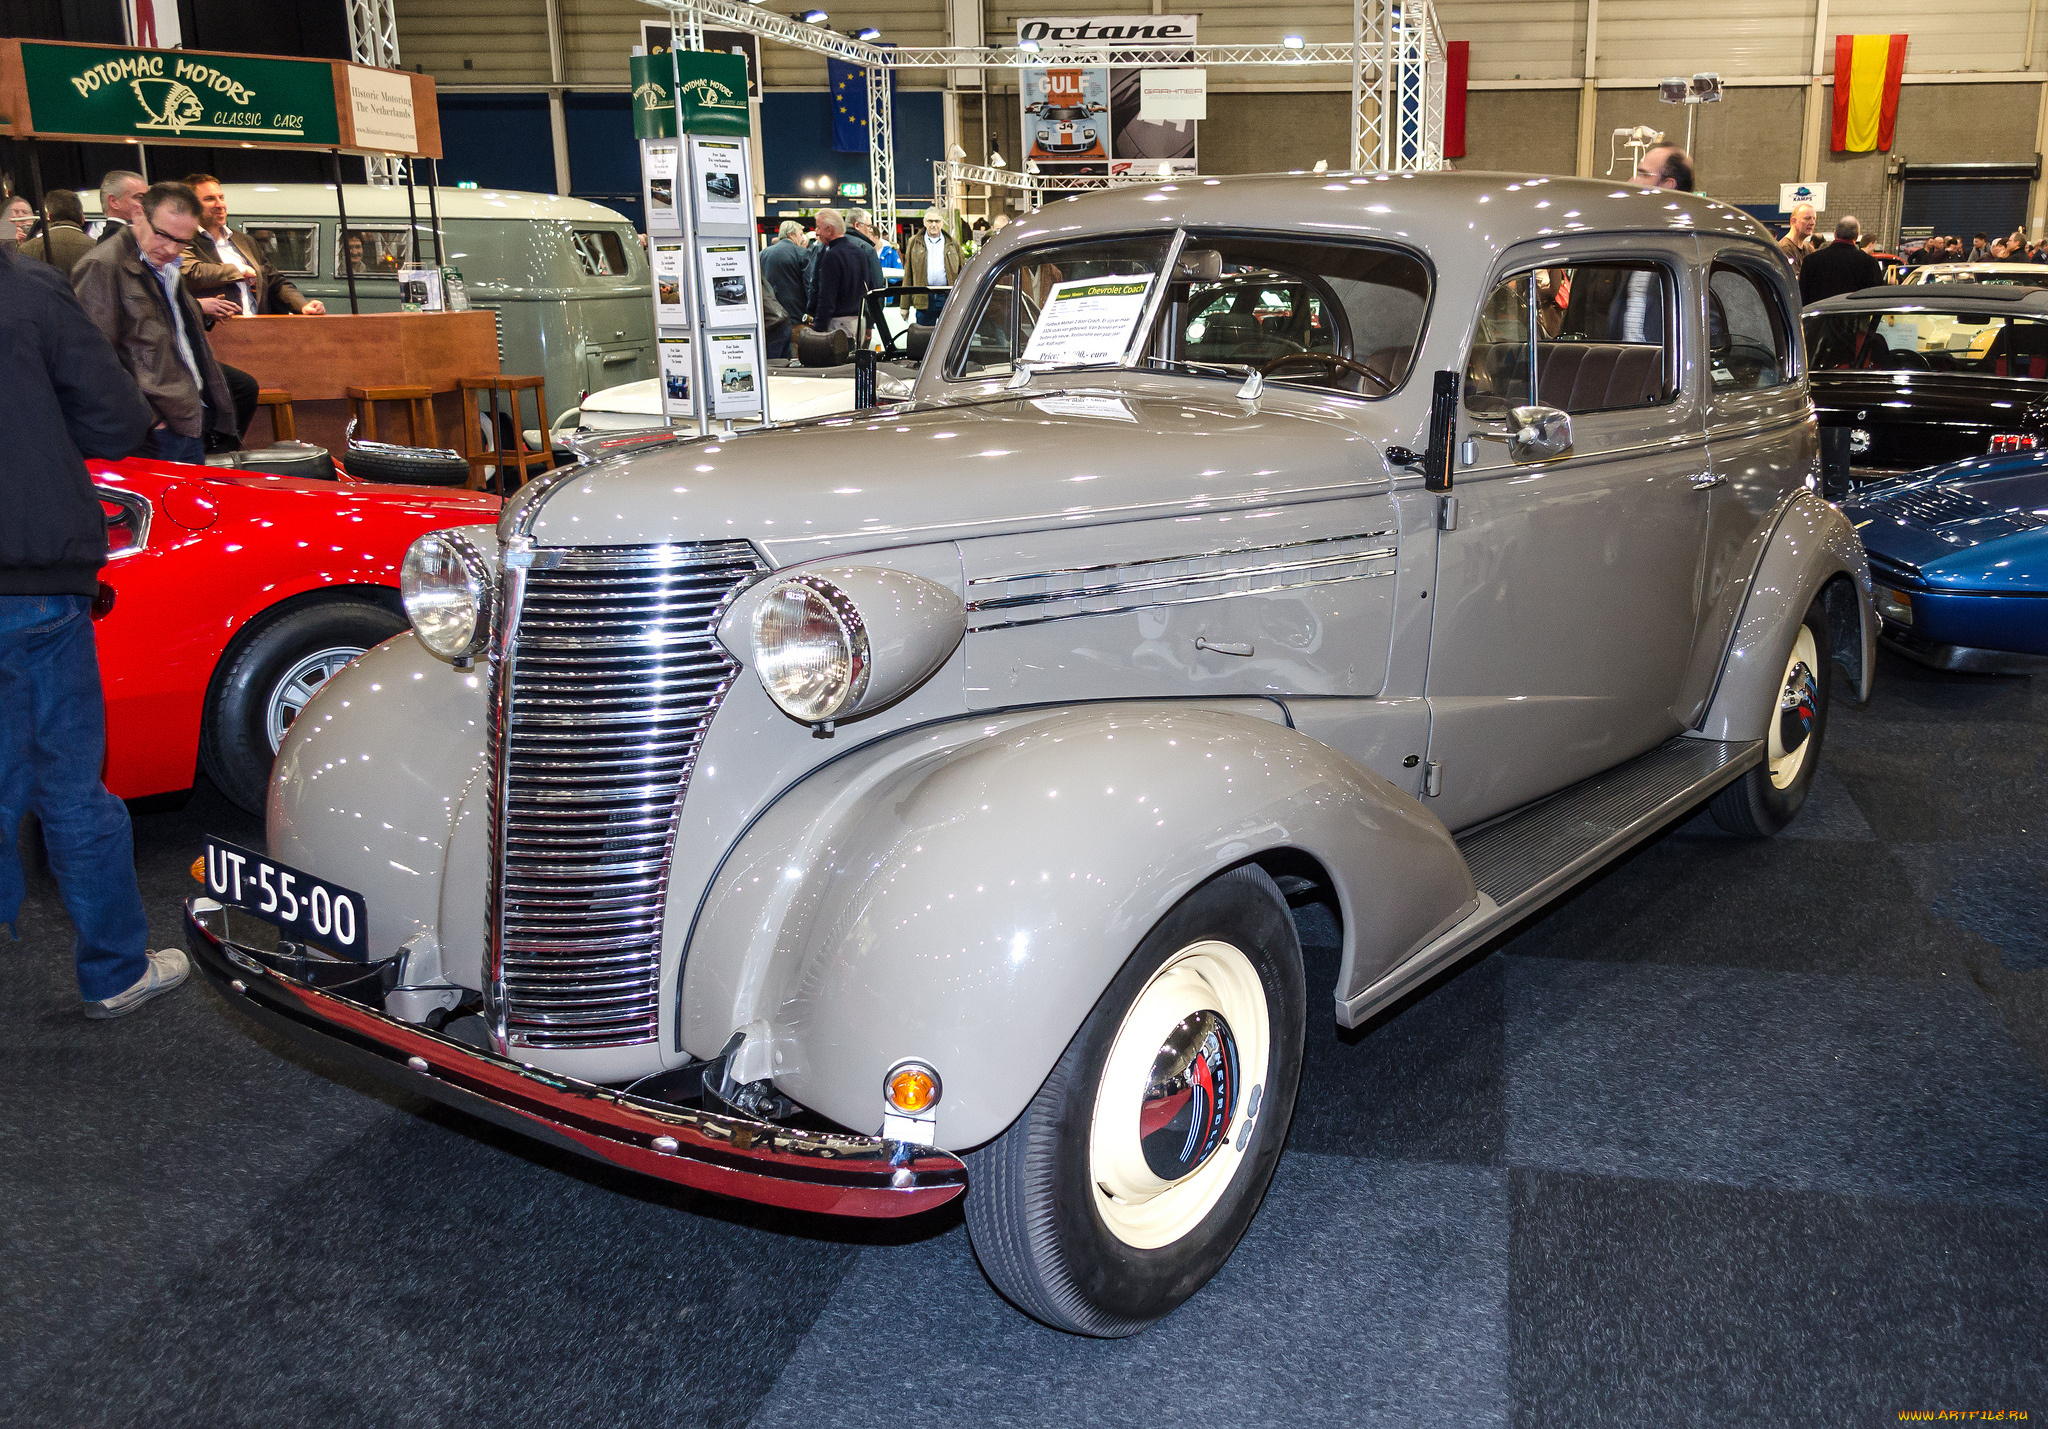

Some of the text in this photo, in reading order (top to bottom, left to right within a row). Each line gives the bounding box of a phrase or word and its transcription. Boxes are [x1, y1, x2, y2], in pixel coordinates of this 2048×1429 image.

[1021, 21, 1194, 40] Octane
[71, 55, 256, 105] POTOMAC MOTORS
[681, 78, 733, 98] POTOMAC MOTORS
[1038, 75, 1091, 94] GULF
[351, 86, 412, 108] Historic Motoring
[355, 101, 412, 119] The Netherlands
[213, 111, 304, 129] CLASSIC CARS
[1059, 122, 1074, 131] 34
[1087, 285, 1122, 296] Chevrolet
[1123, 284, 1144, 294] Coach
[1040, 351, 1060, 360] Price:
[209, 844, 356, 945] UT-55-00
